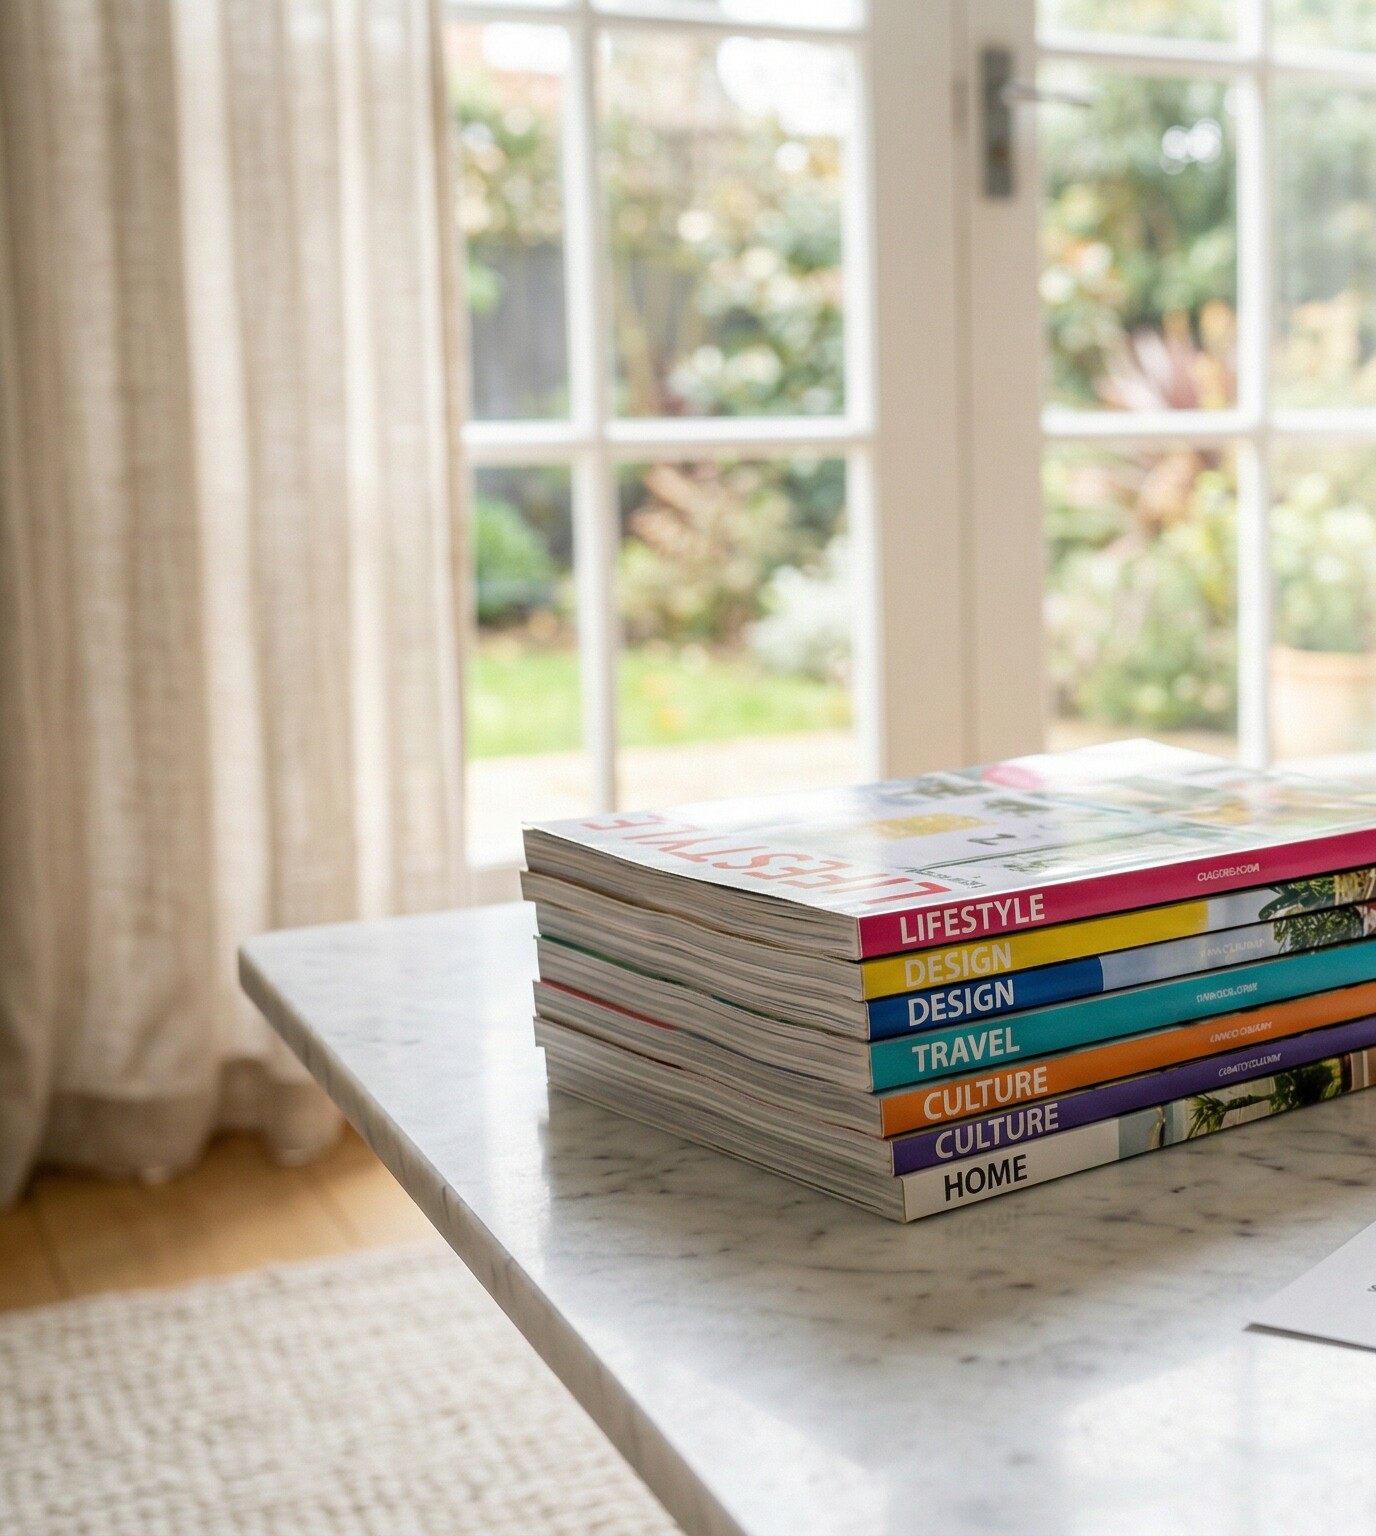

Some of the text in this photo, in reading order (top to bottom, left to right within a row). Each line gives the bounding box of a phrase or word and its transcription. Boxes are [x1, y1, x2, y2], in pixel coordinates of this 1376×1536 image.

[581, 815, 952, 907] LIFESTYLE
[900, 893, 1045, 944] LIFESTYLE
[904, 942, 1012, 988] DESIGN
[907, 979, 1014, 1027] DESIGN
[912, 1027, 1020, 1073] TRAVEL
[923, 1066, 1048, 1120] CULTURE
[935, 1102, 1059, 1159] CULTURE
[944, 1154, 1028, 1202] HOME
